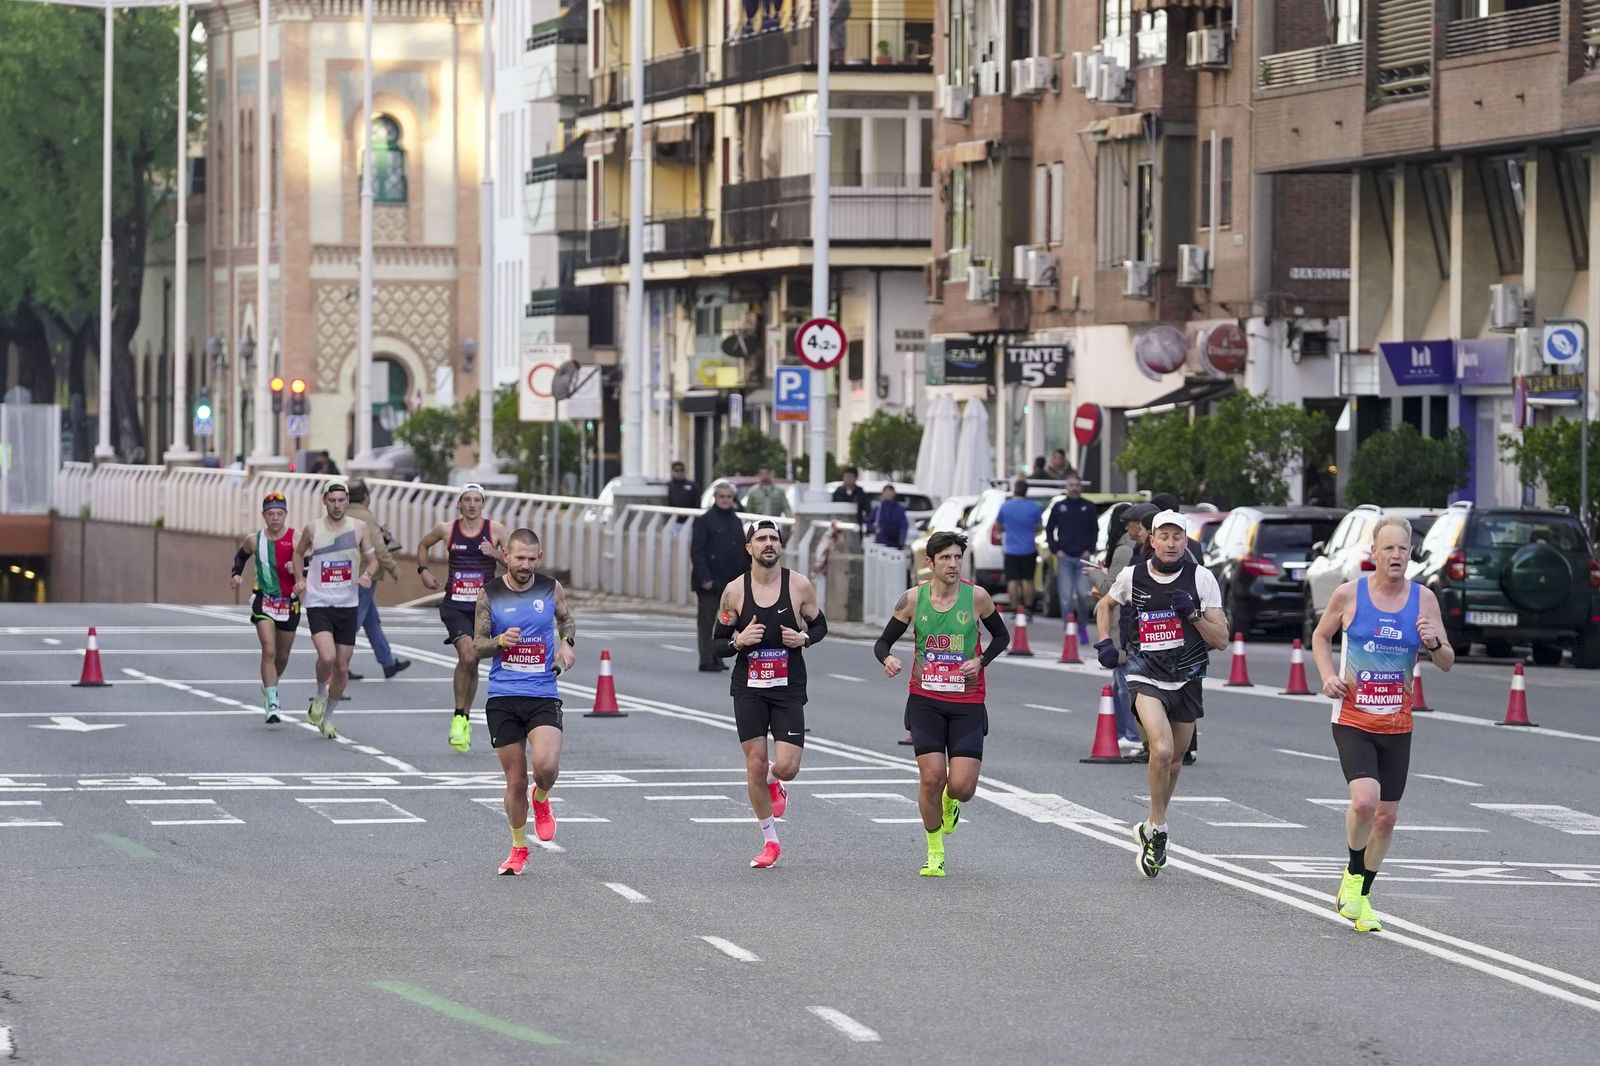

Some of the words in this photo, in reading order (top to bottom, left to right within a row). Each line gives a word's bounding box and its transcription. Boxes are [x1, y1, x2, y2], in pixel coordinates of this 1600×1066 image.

[1006, 348, 1064, 363] TINTE
[1021, 362, 1057, 388] 5€
[780, 371, 802, 402] P
[1151, 611, 1176, 620] ZURICH
[1145, 630, 1178, 642] FREDDY
[925, 633, 965, 651] ADN
[1375, 643, 1409, 654] Klaverblad
[507, 654, 541, 663] ANDRES
[760, 670, 775, 679] SER
[921, 673, 943, 682] LUCAS
[949, 674, 966, 683] INES
[1356, 694, 1403, 705] FRANKWIN
